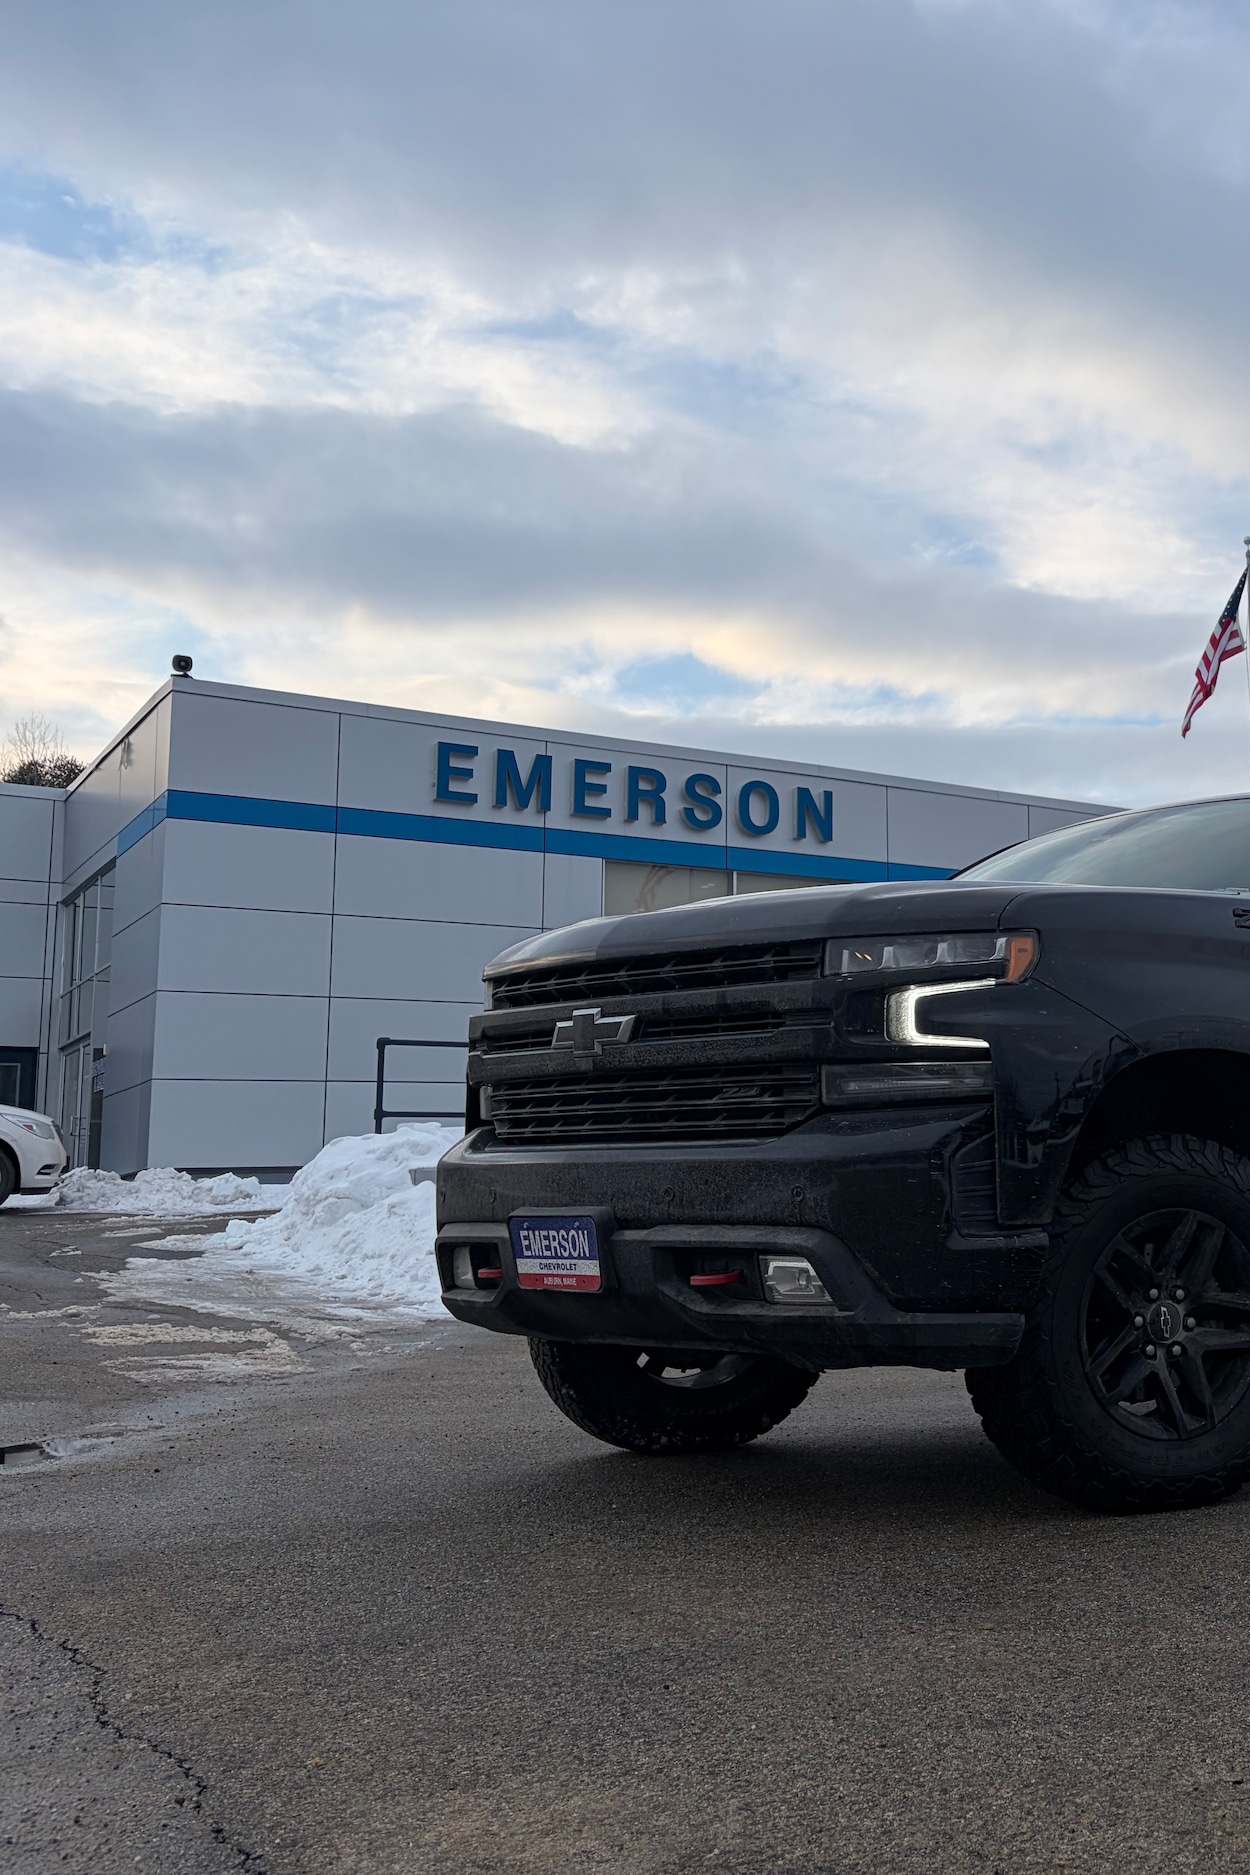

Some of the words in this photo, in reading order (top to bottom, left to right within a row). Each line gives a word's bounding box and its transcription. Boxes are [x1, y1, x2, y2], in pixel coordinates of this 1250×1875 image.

[434, 741, 834, 843] EMERSON
[520, 1229, 590, 1258] EMERSON
[539, 1262, 577, 1271] CHEVROLET
